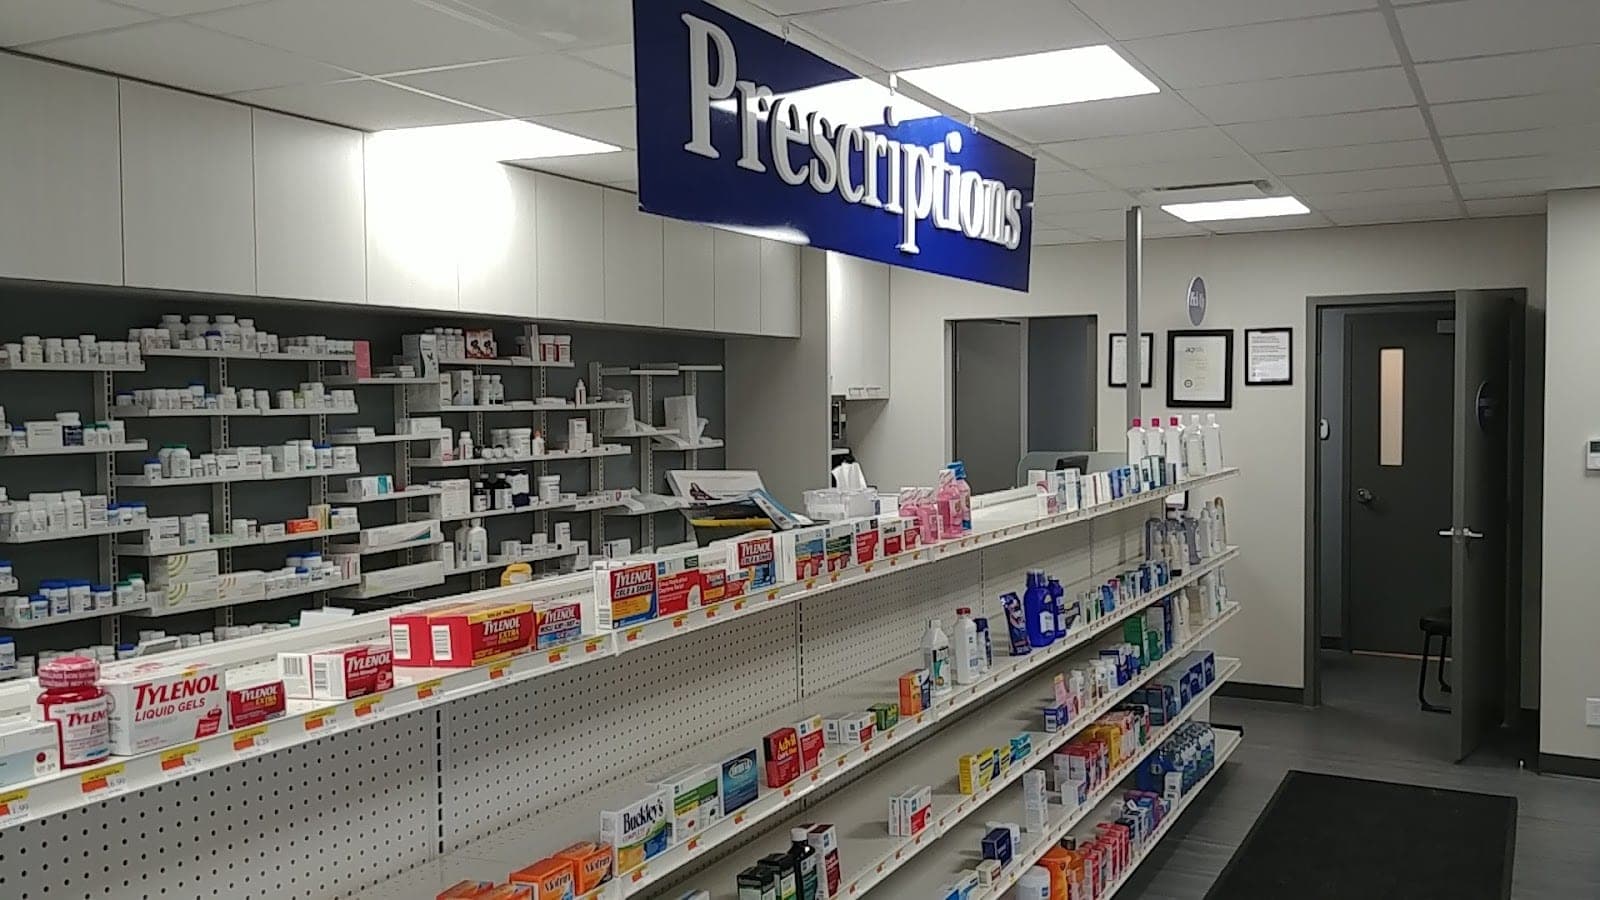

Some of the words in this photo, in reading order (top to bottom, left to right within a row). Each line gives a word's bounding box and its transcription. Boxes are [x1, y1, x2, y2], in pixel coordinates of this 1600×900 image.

[681, 13, 1022, 254] Prescriptions
[614, 568, 653, 588] TYLENOL
[483, 616, 521, 636] TYLENOL
[346, 652, 391, 674] TYLENOL
[132, 673, 220, 711] TYLENOL
[240, 685, 279, 703] TYLENOL
[134, 706, 175, 722] LIQUID
[178, 697, 206, 712] GELS
[623, 798, 664, 835] Buckley's
